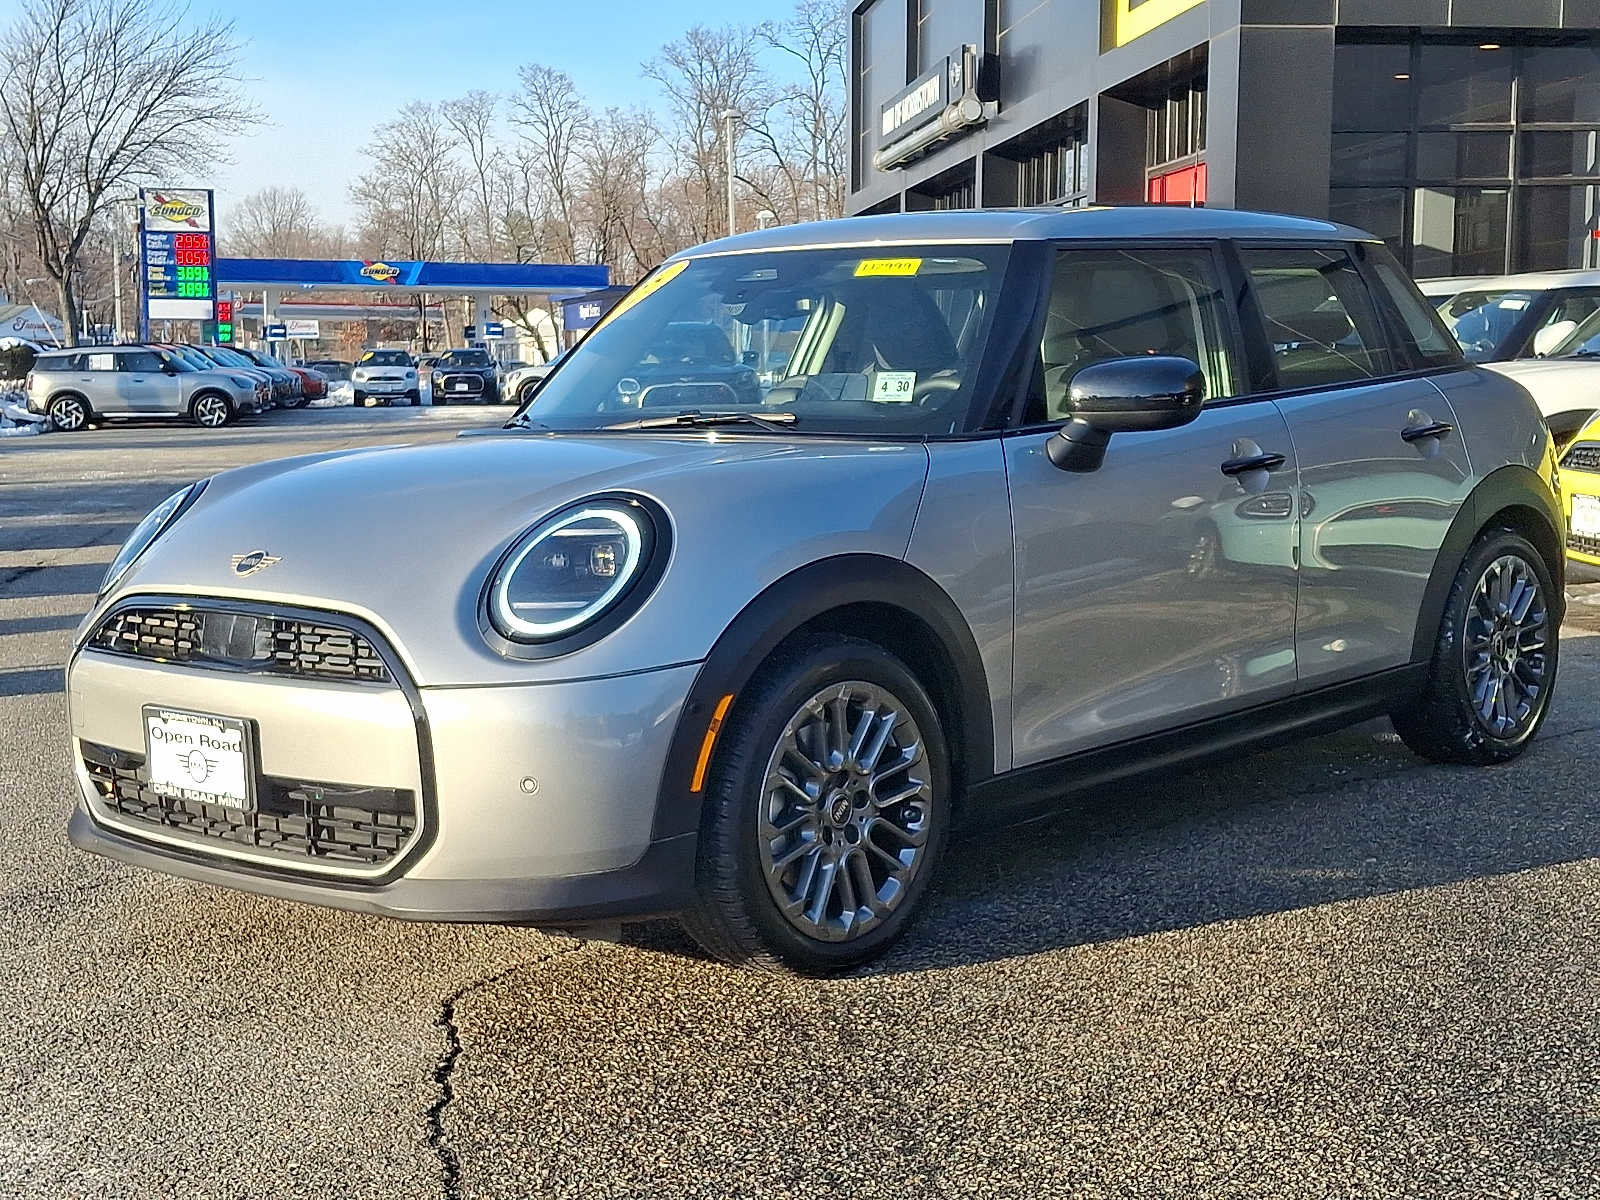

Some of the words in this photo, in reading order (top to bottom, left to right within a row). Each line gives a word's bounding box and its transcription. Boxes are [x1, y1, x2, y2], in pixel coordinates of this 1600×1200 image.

[153, 206, 200, 216] SUNOCO
[362, 267, 398, 275] SUNOCO
[881, 381, 888, 392] 4
[896, 380, 910, 392] 30
[152, 726, 194, 745] Open
[200, 734, 243, 753] Road
[153, 783, 182, 799] OPEN
[183, 789, 216, 805] ROAD
[217, 795, 243, 809] MINI
[833, 799, 849, 821] MINI
